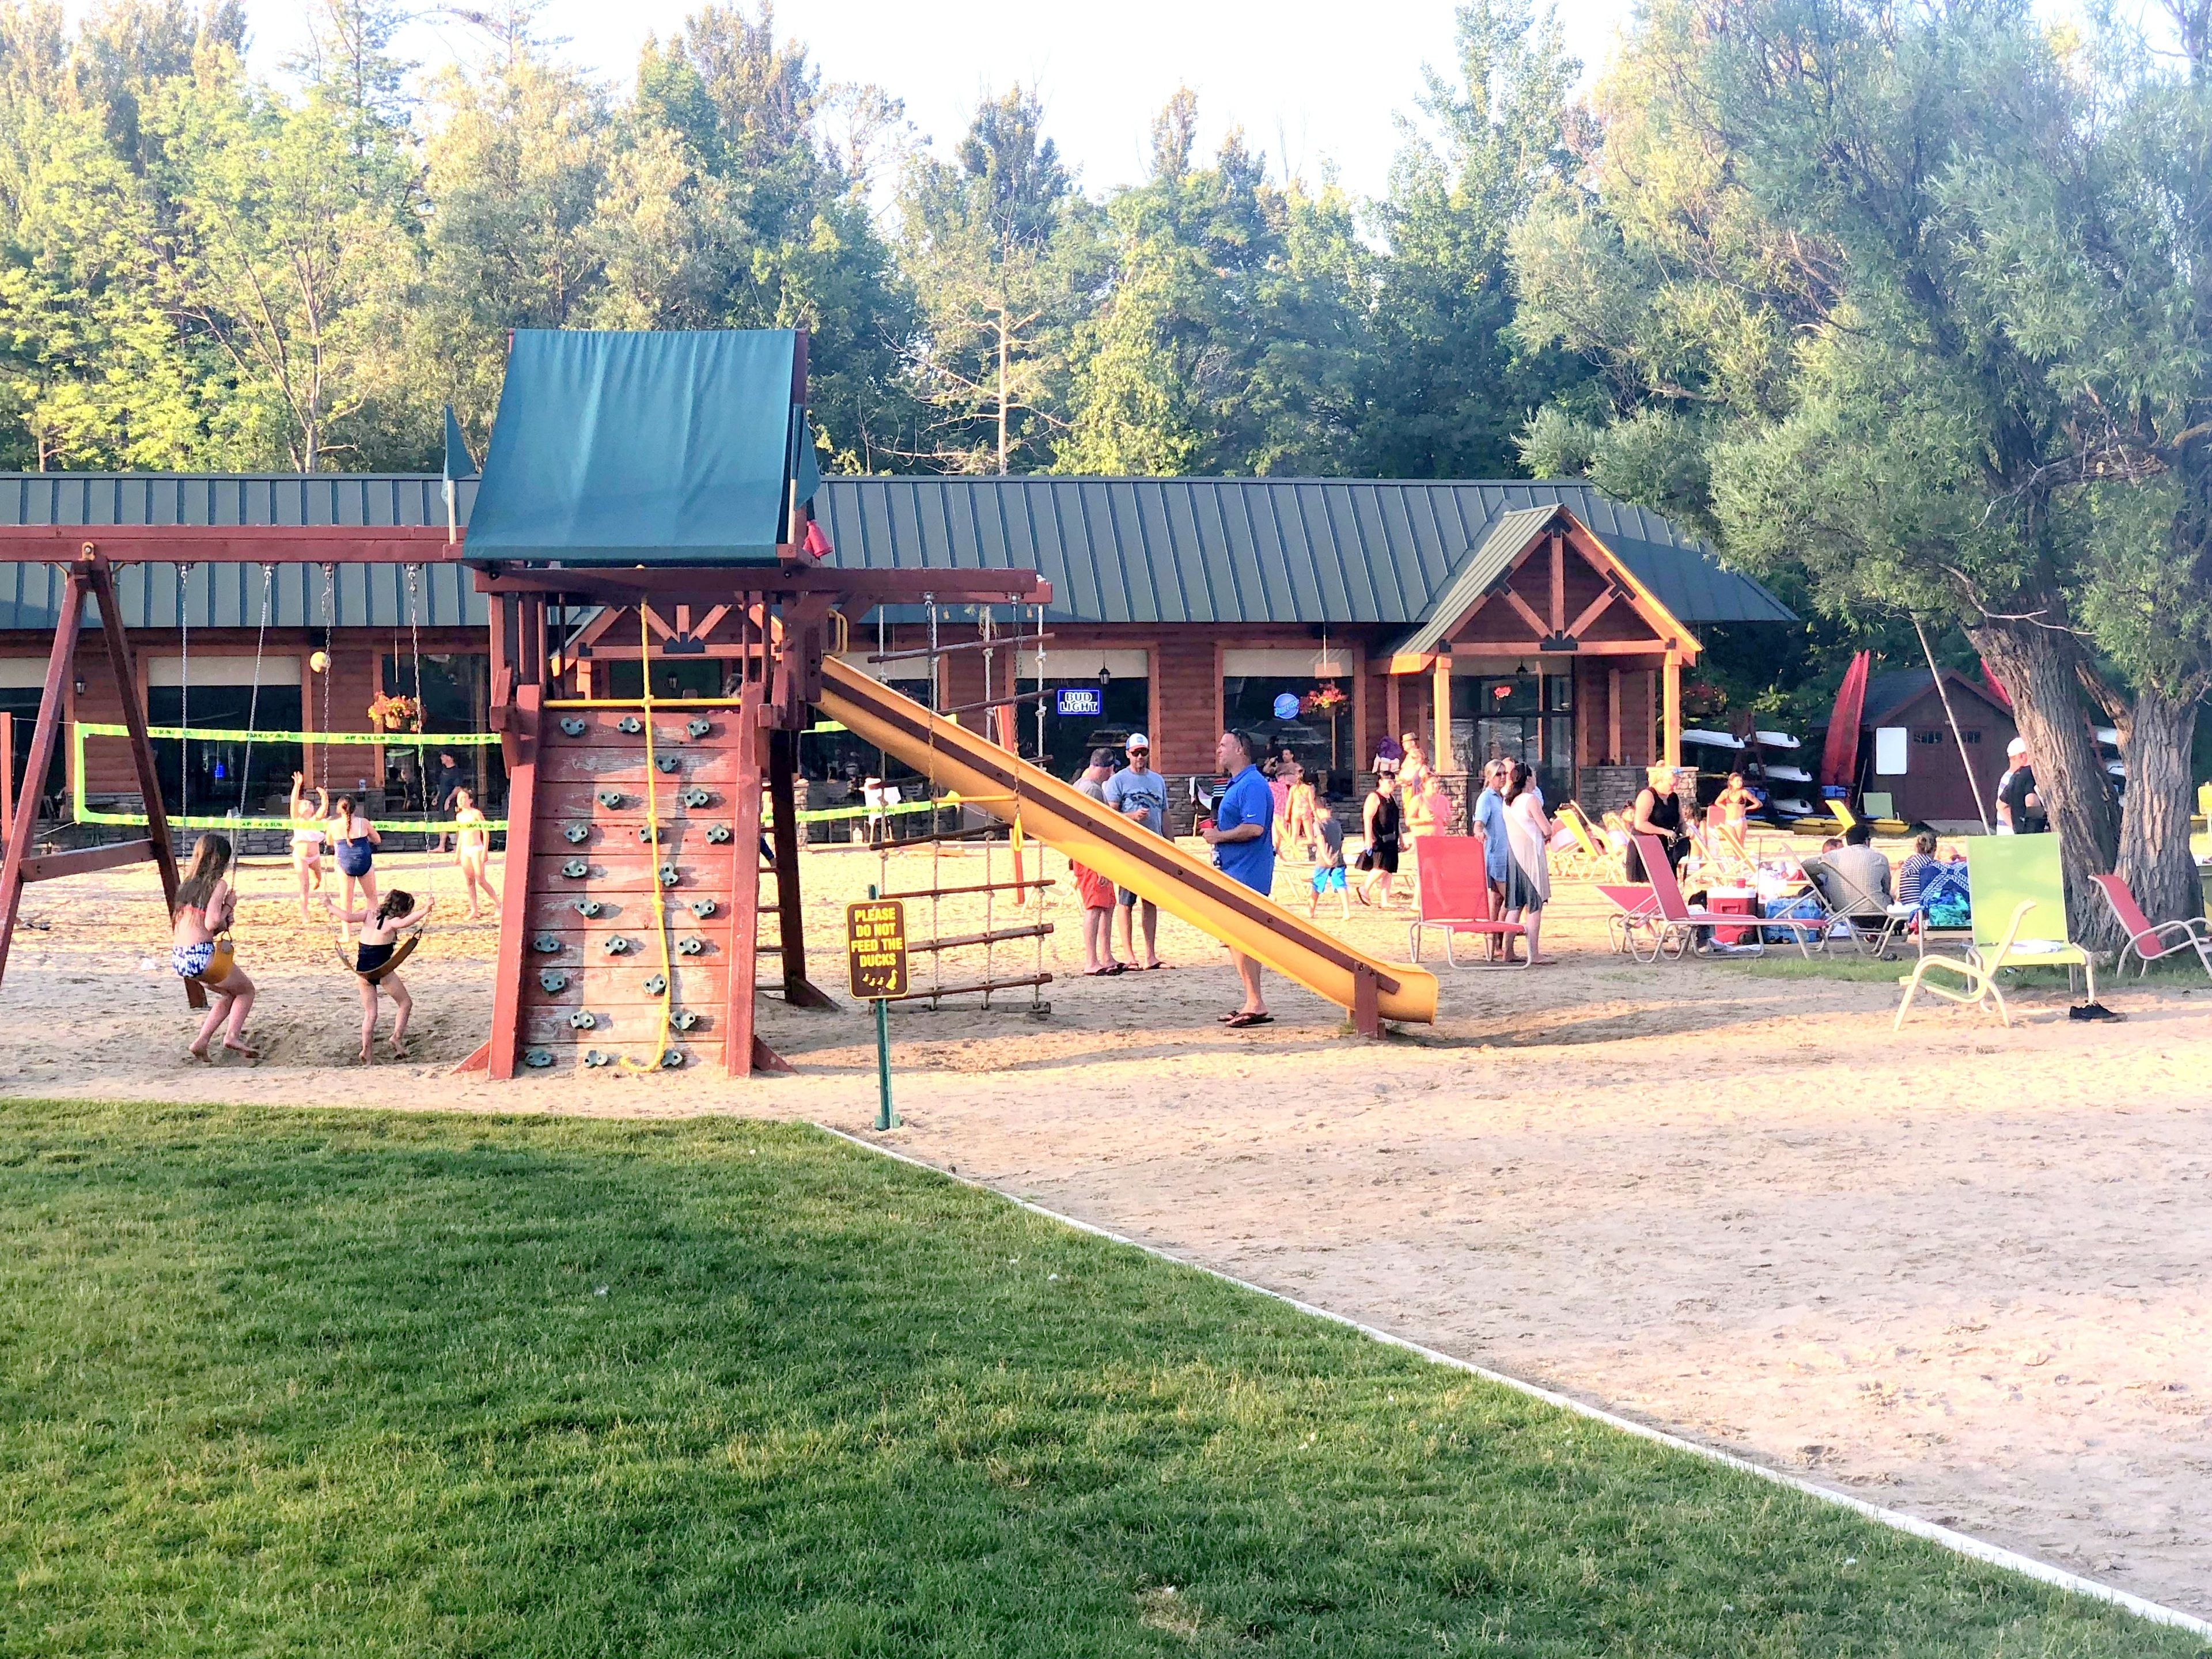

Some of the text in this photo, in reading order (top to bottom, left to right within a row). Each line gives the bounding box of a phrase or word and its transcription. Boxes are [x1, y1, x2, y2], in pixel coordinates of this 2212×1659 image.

[1065, 692, 1093, 702] BUD
[1059, 702, 1098, 712] LIGHT
[854, 907, 896, 922] PLEASE
[855, 923, 896, 938] DO NOT
[851, 937, 903, 953] FEED THE
[859, 953, 896, 968] DUCKS
